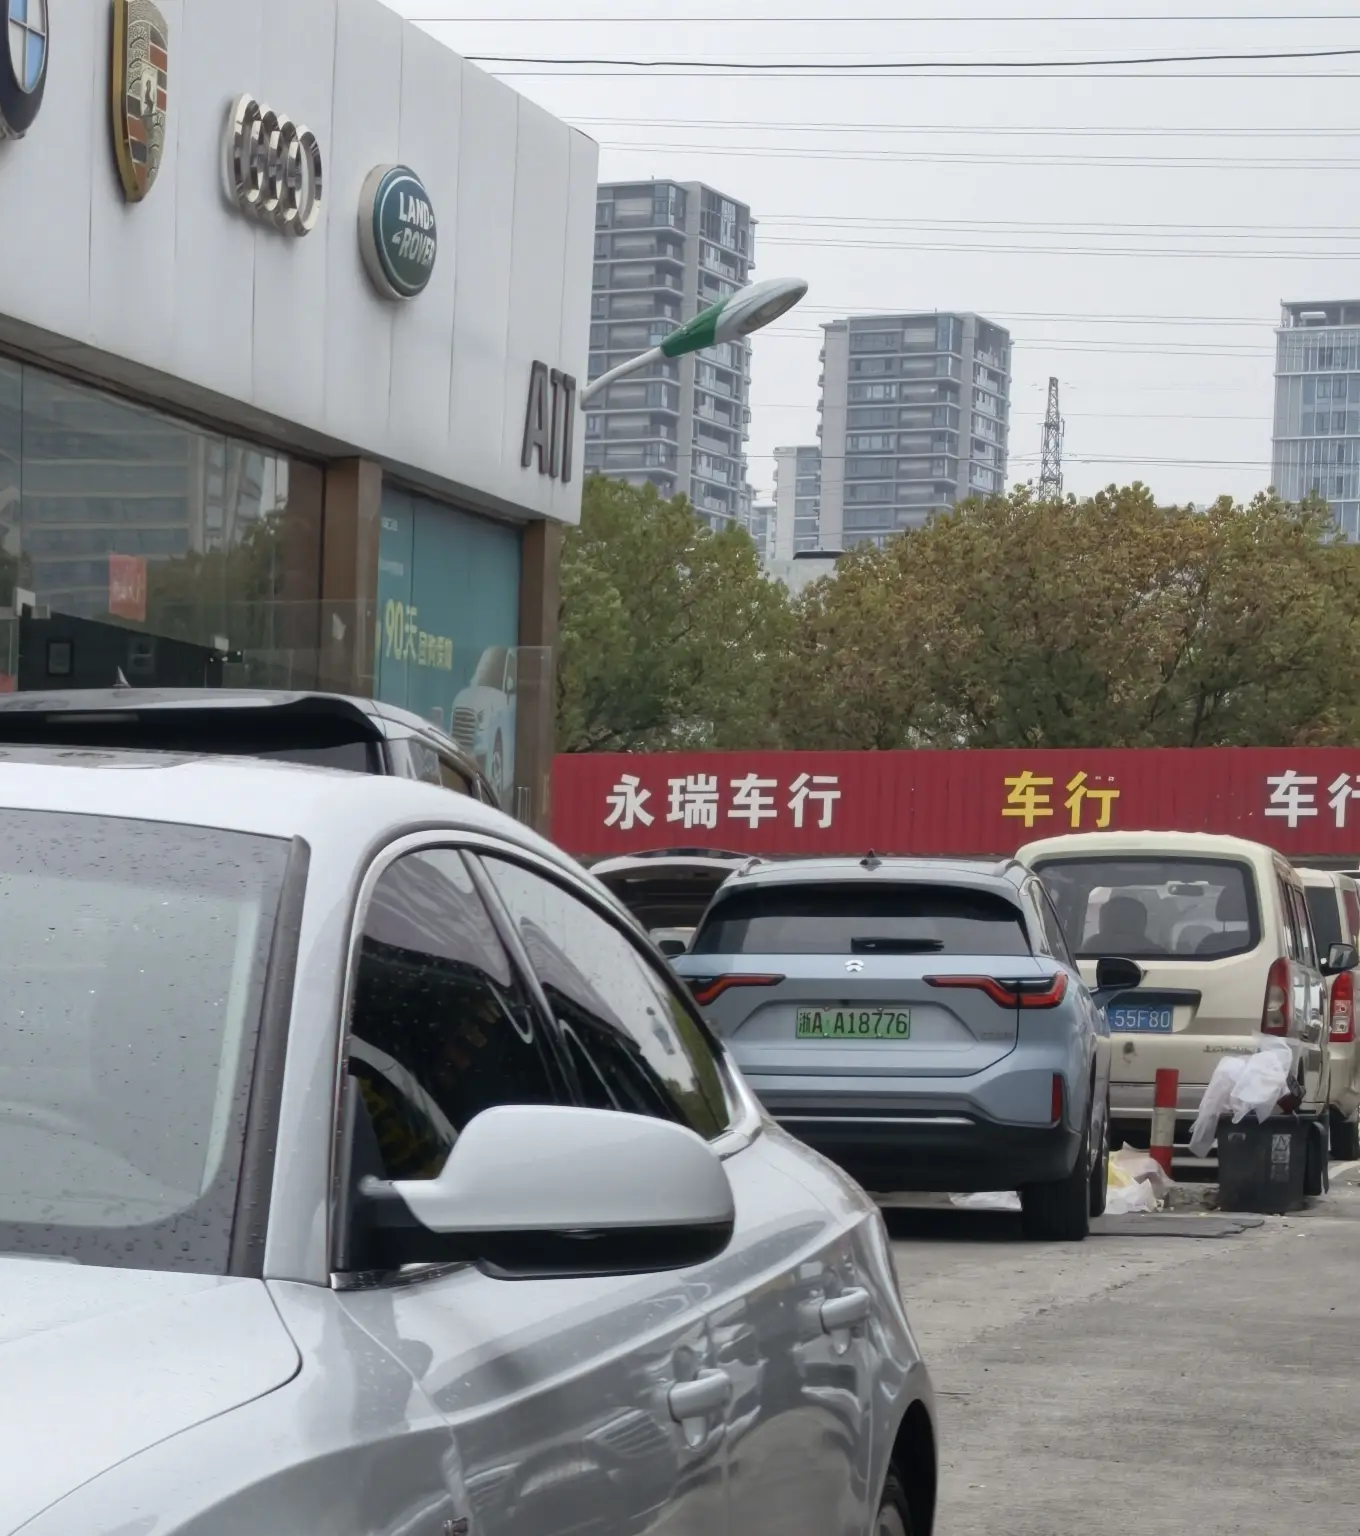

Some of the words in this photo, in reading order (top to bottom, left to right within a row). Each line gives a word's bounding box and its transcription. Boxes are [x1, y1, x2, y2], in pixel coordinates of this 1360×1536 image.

[398, 191, 431, 231] LAND
[397, 227, 436, 268] ROVER
[603, 772, 842, 830] 永瑞车行
[1001, 770, 1121, 828] 车行
